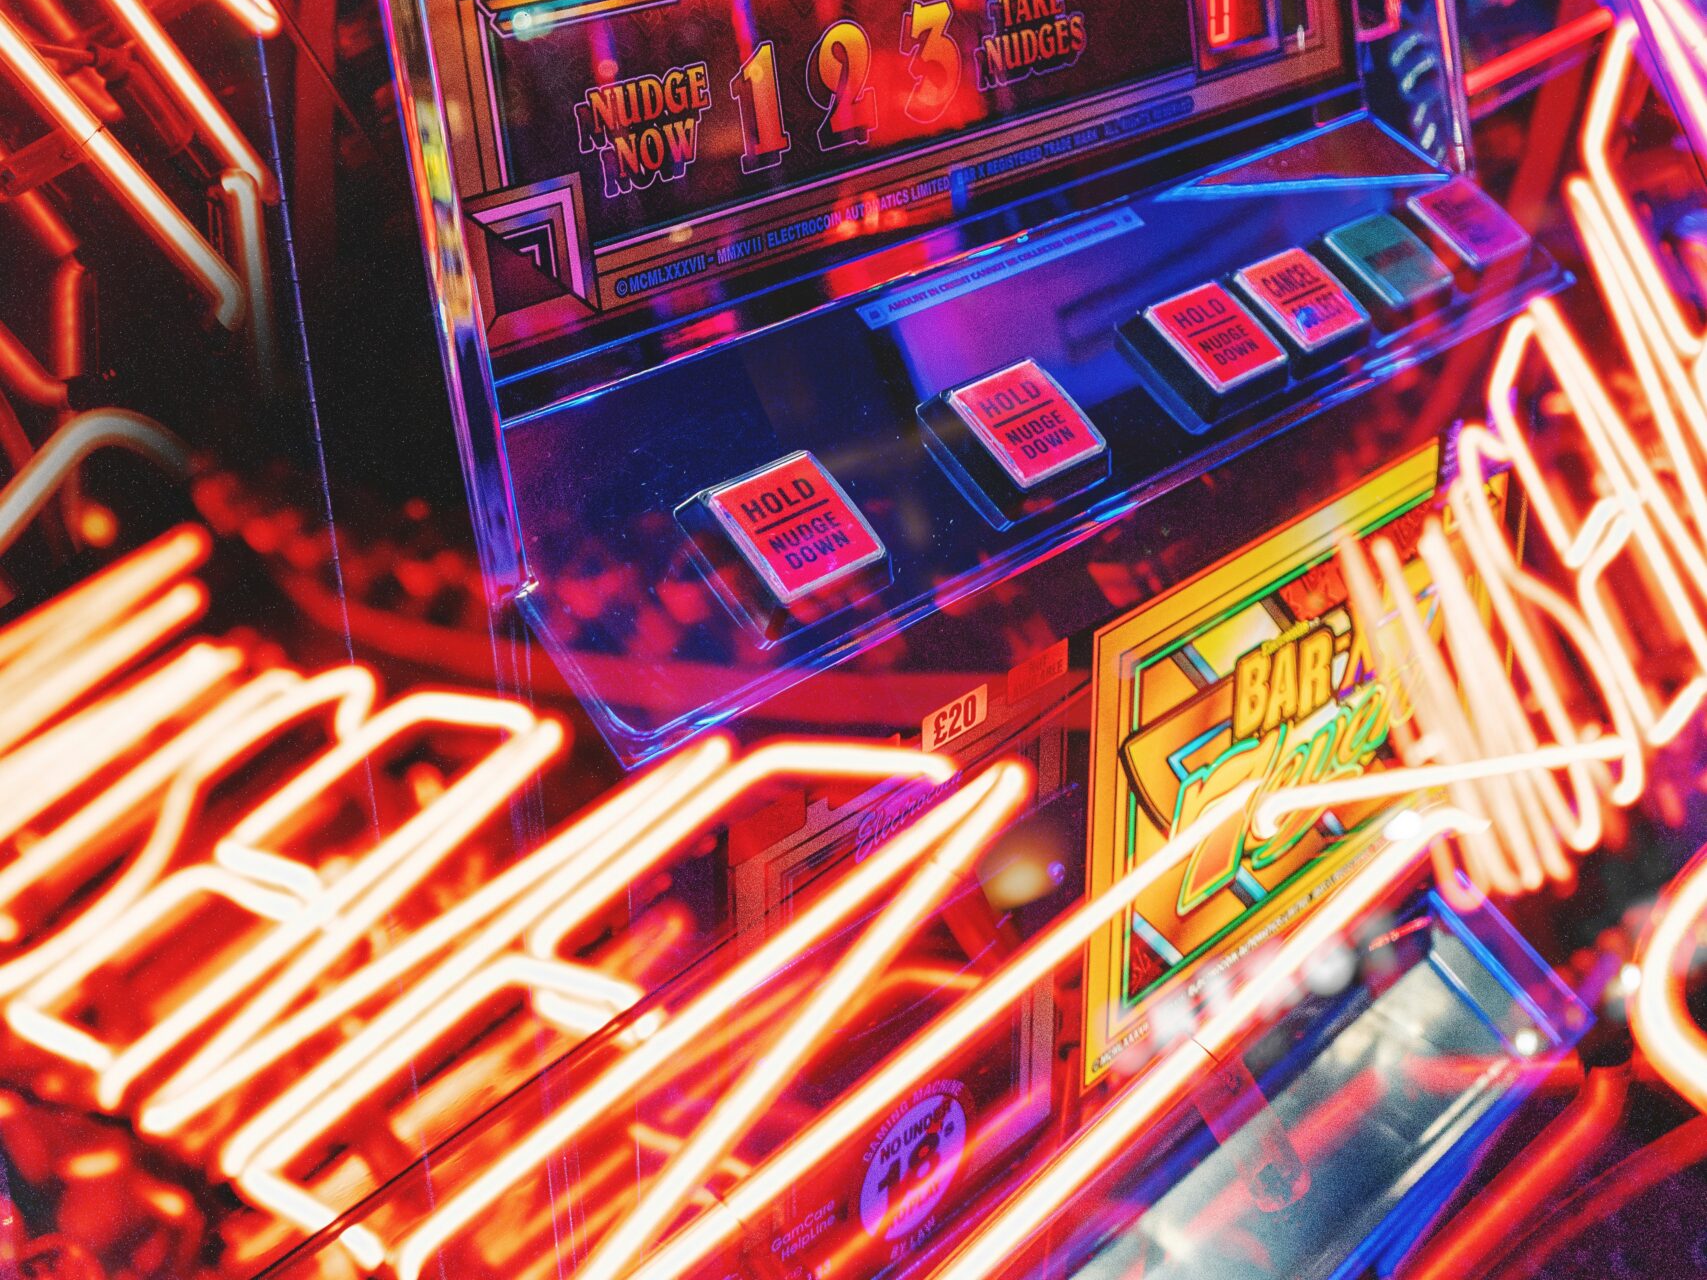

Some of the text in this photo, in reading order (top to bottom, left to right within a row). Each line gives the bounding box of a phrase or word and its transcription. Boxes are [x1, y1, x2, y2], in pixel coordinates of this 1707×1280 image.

[983, 18, 1085, 76] NUDGES
[588, 66, 709, 132] NUDGE
[744, 4, 962, 156] 1 2 3
[613, 118, 697, 178] NOW
[716, 236, 763, 265] MMXVII
[766, 213, 842, 249] ELECTROCOIN
[845, 187, 910, 220] AUTOMATICS
[910, 176, 951, 202] LIMITED
[986, 144, 1044, 175] REGISTERED
[1261, 263, 1321, 298] CANCEL
[887, 290, 928, 313] AMOUNT
[1173, 297, 1227, 330] HOLD
[1198, 324, 1249, 354] NUDGE
[1214, 339, 1259, 366] DOWN
[978, 380, 1043, 419] HOLD
[1004, 408, 1066, 447] NUDGE
[1020, 425, 1075, 461] DOWN
[740, 477, 816, 525] HOLD
[768, 510, 843, 554] NUDGE
[784, 530, 851, 571] DOWN
[933, 697, 977, 746] £20
[880, 1136, 901, 1165] NO
[771, 1199, 835, 1253] GamCare
